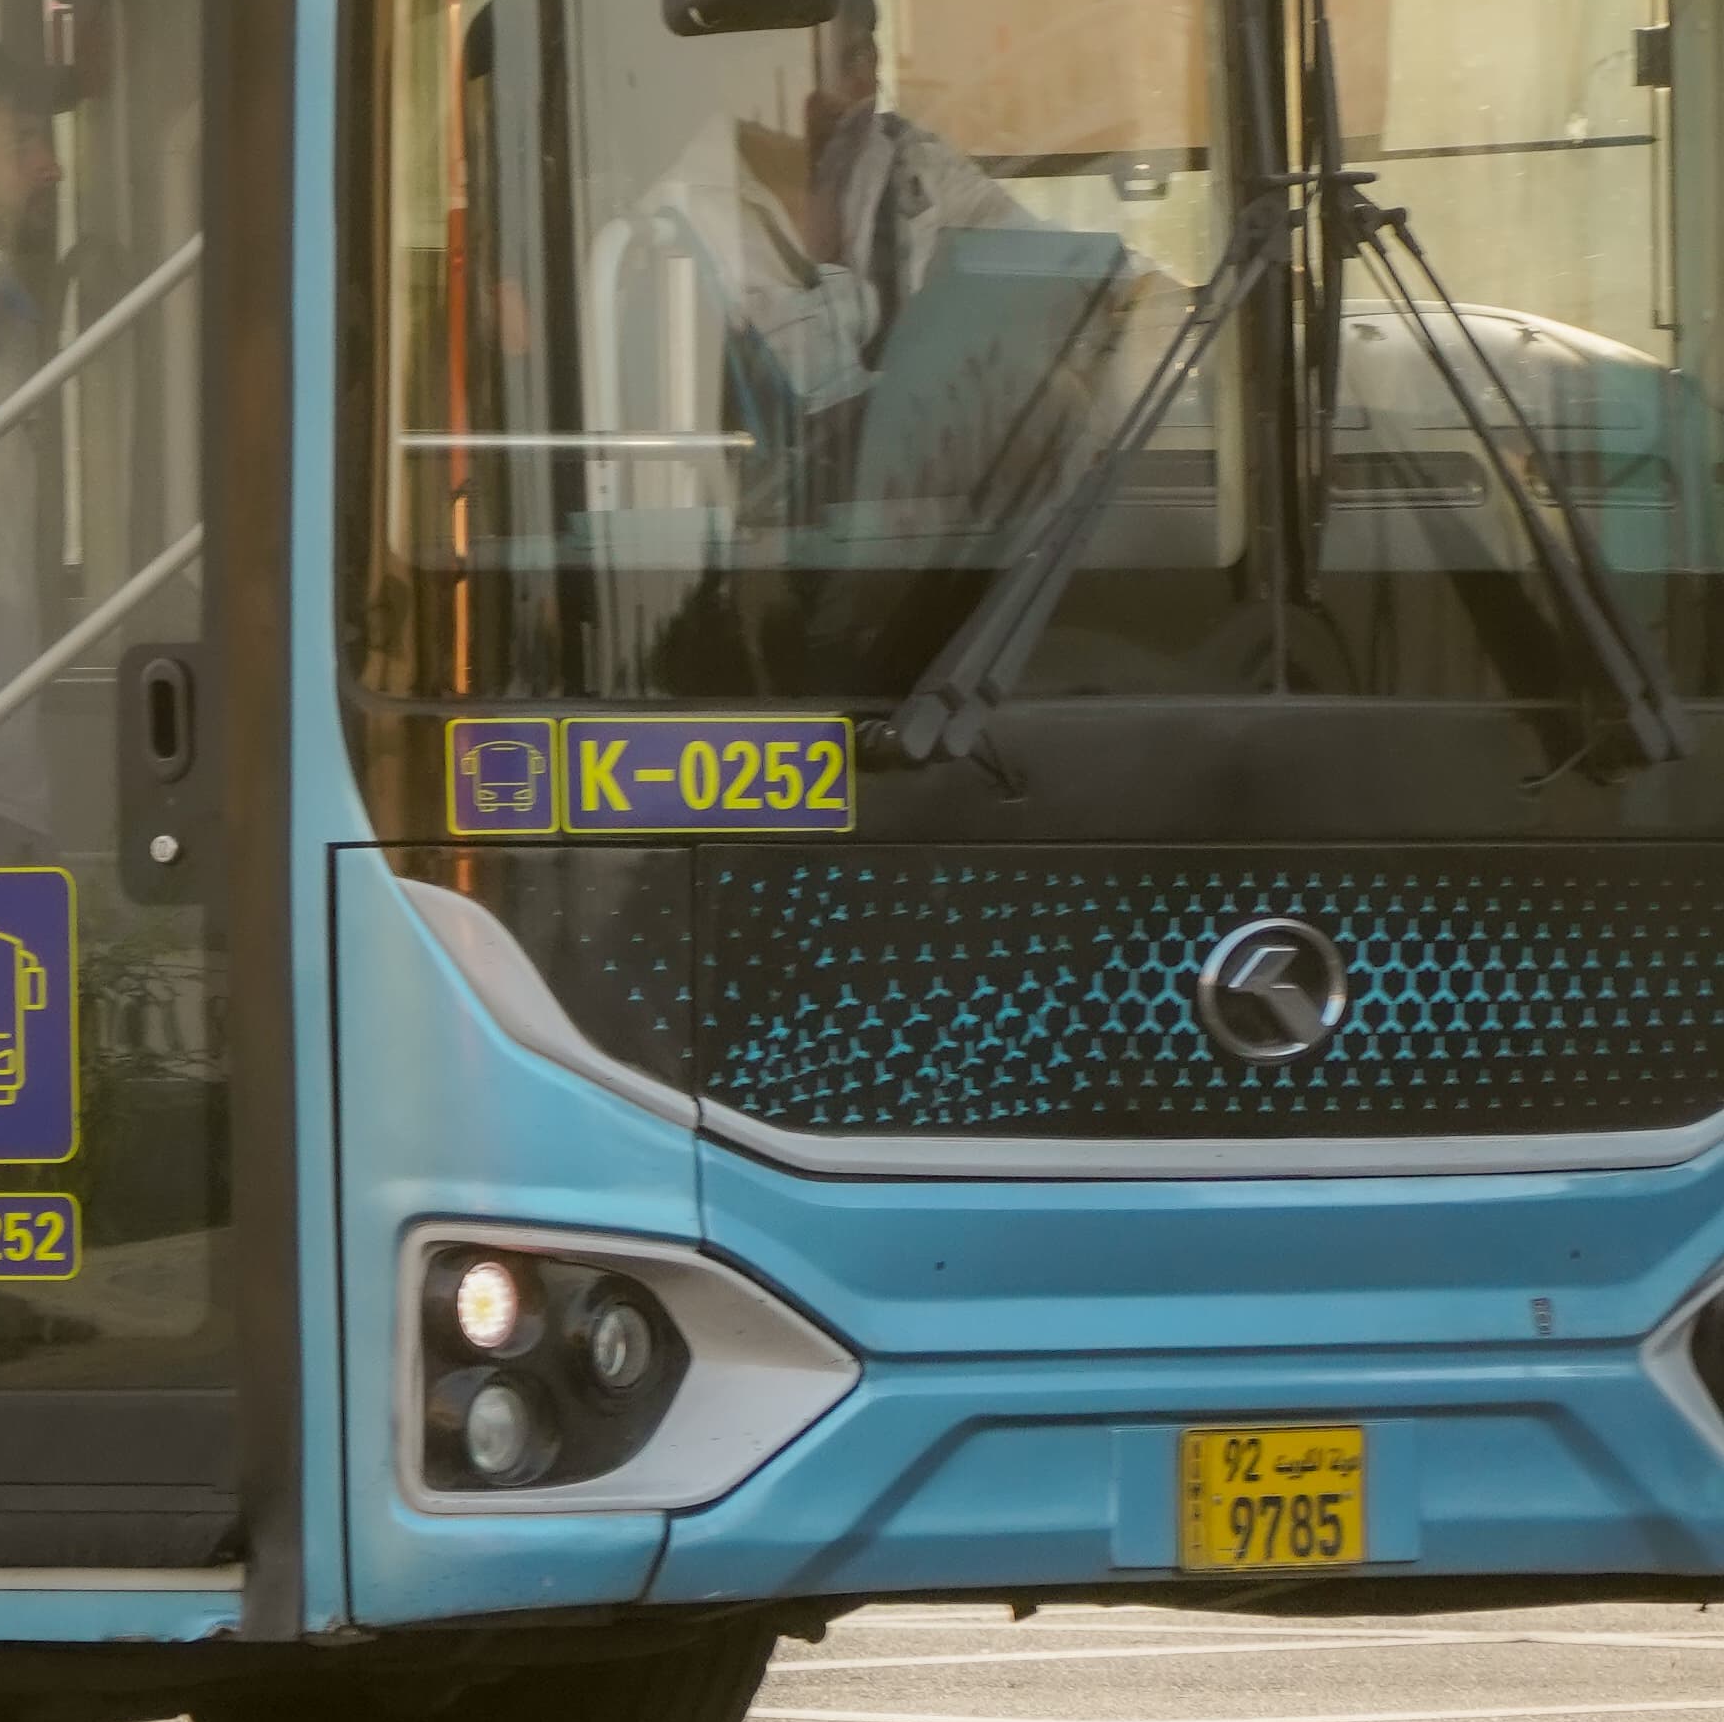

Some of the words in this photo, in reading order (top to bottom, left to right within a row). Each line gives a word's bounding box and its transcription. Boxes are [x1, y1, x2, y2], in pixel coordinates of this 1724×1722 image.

[580, 740, 845, 811] K-0252
[1223, 1438, 1261, 1482] 92
[1230, 1493, 1343, 1560] 9785
